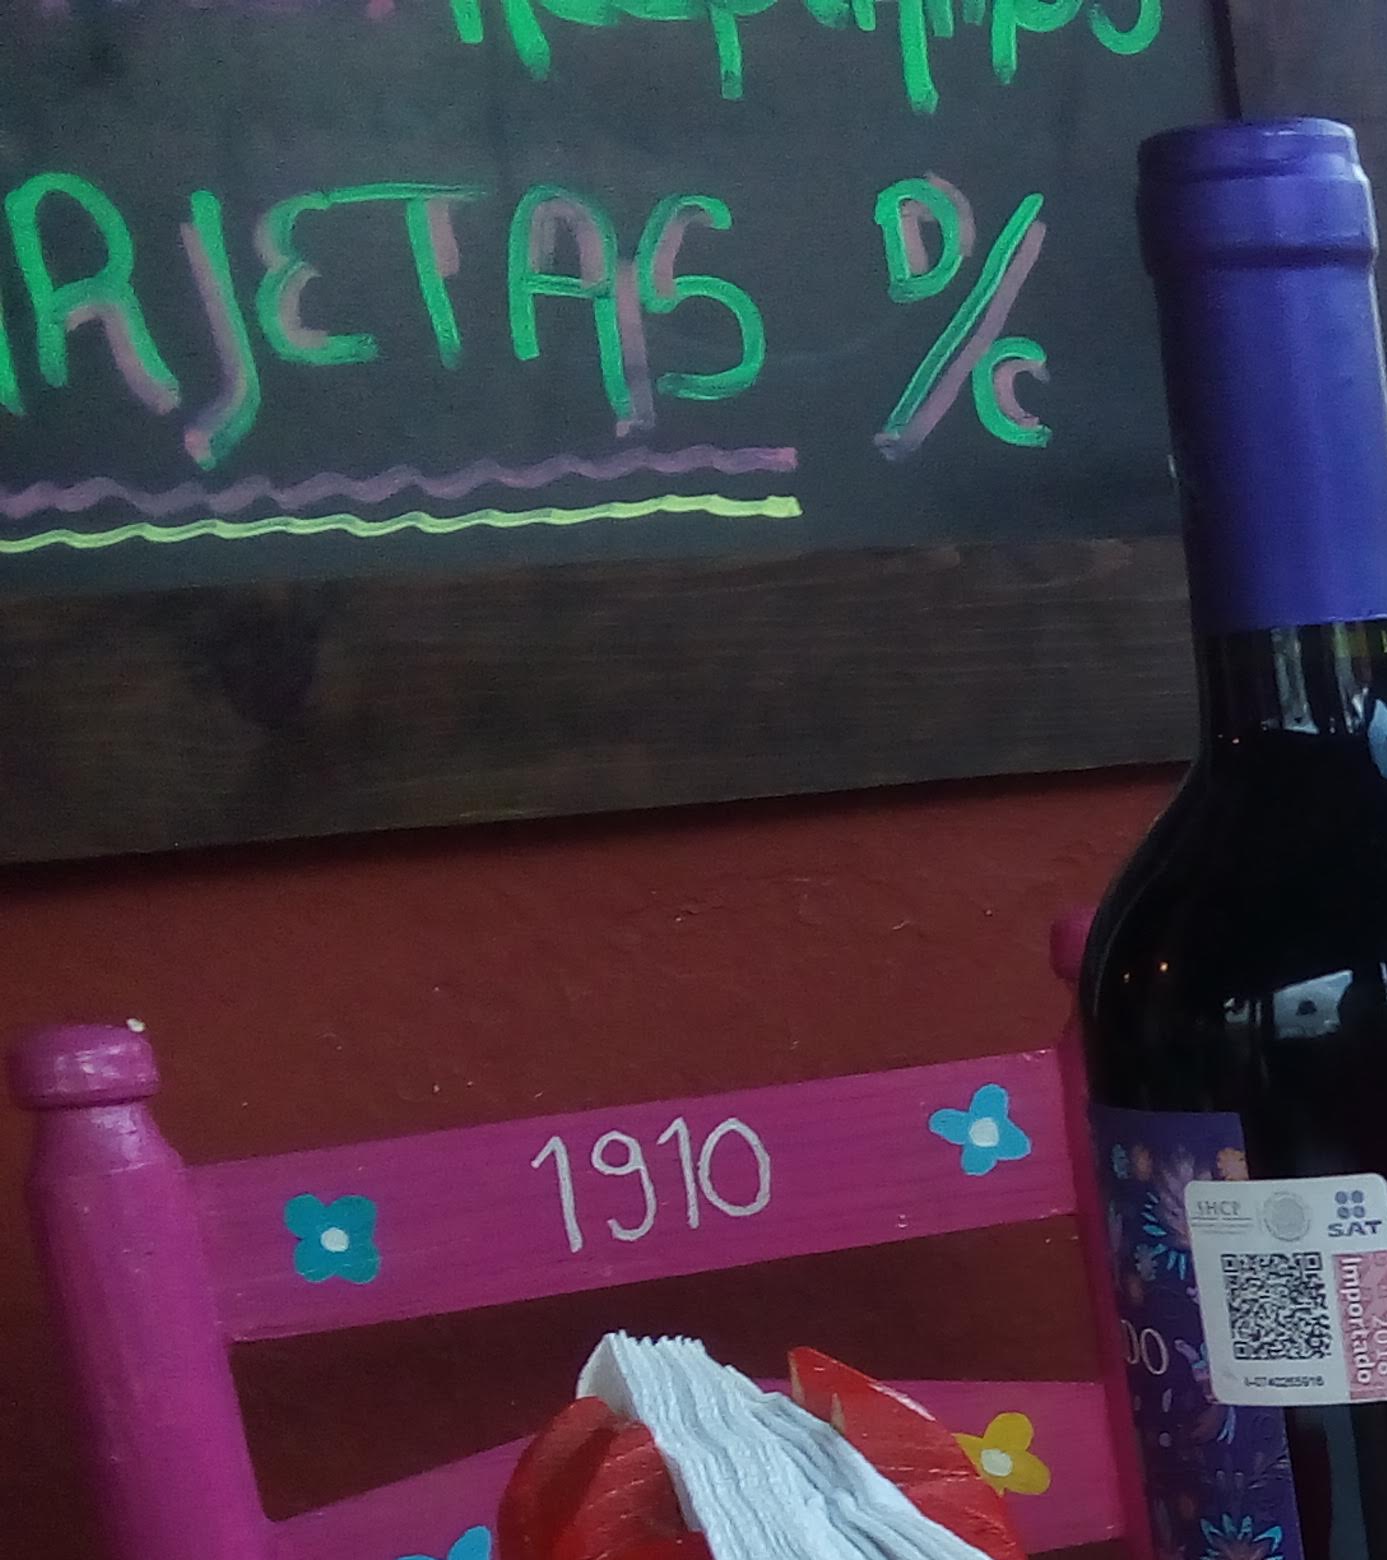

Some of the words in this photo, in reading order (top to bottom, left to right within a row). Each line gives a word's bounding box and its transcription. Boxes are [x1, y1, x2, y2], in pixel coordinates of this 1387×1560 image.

[0, 170, 766, 470] RJETAS
[531, 1118, 772, 1253] 1910
[1328, 1219, 1382, 1238] SAT
[1338, 1257, 1376, 1385] Importado
